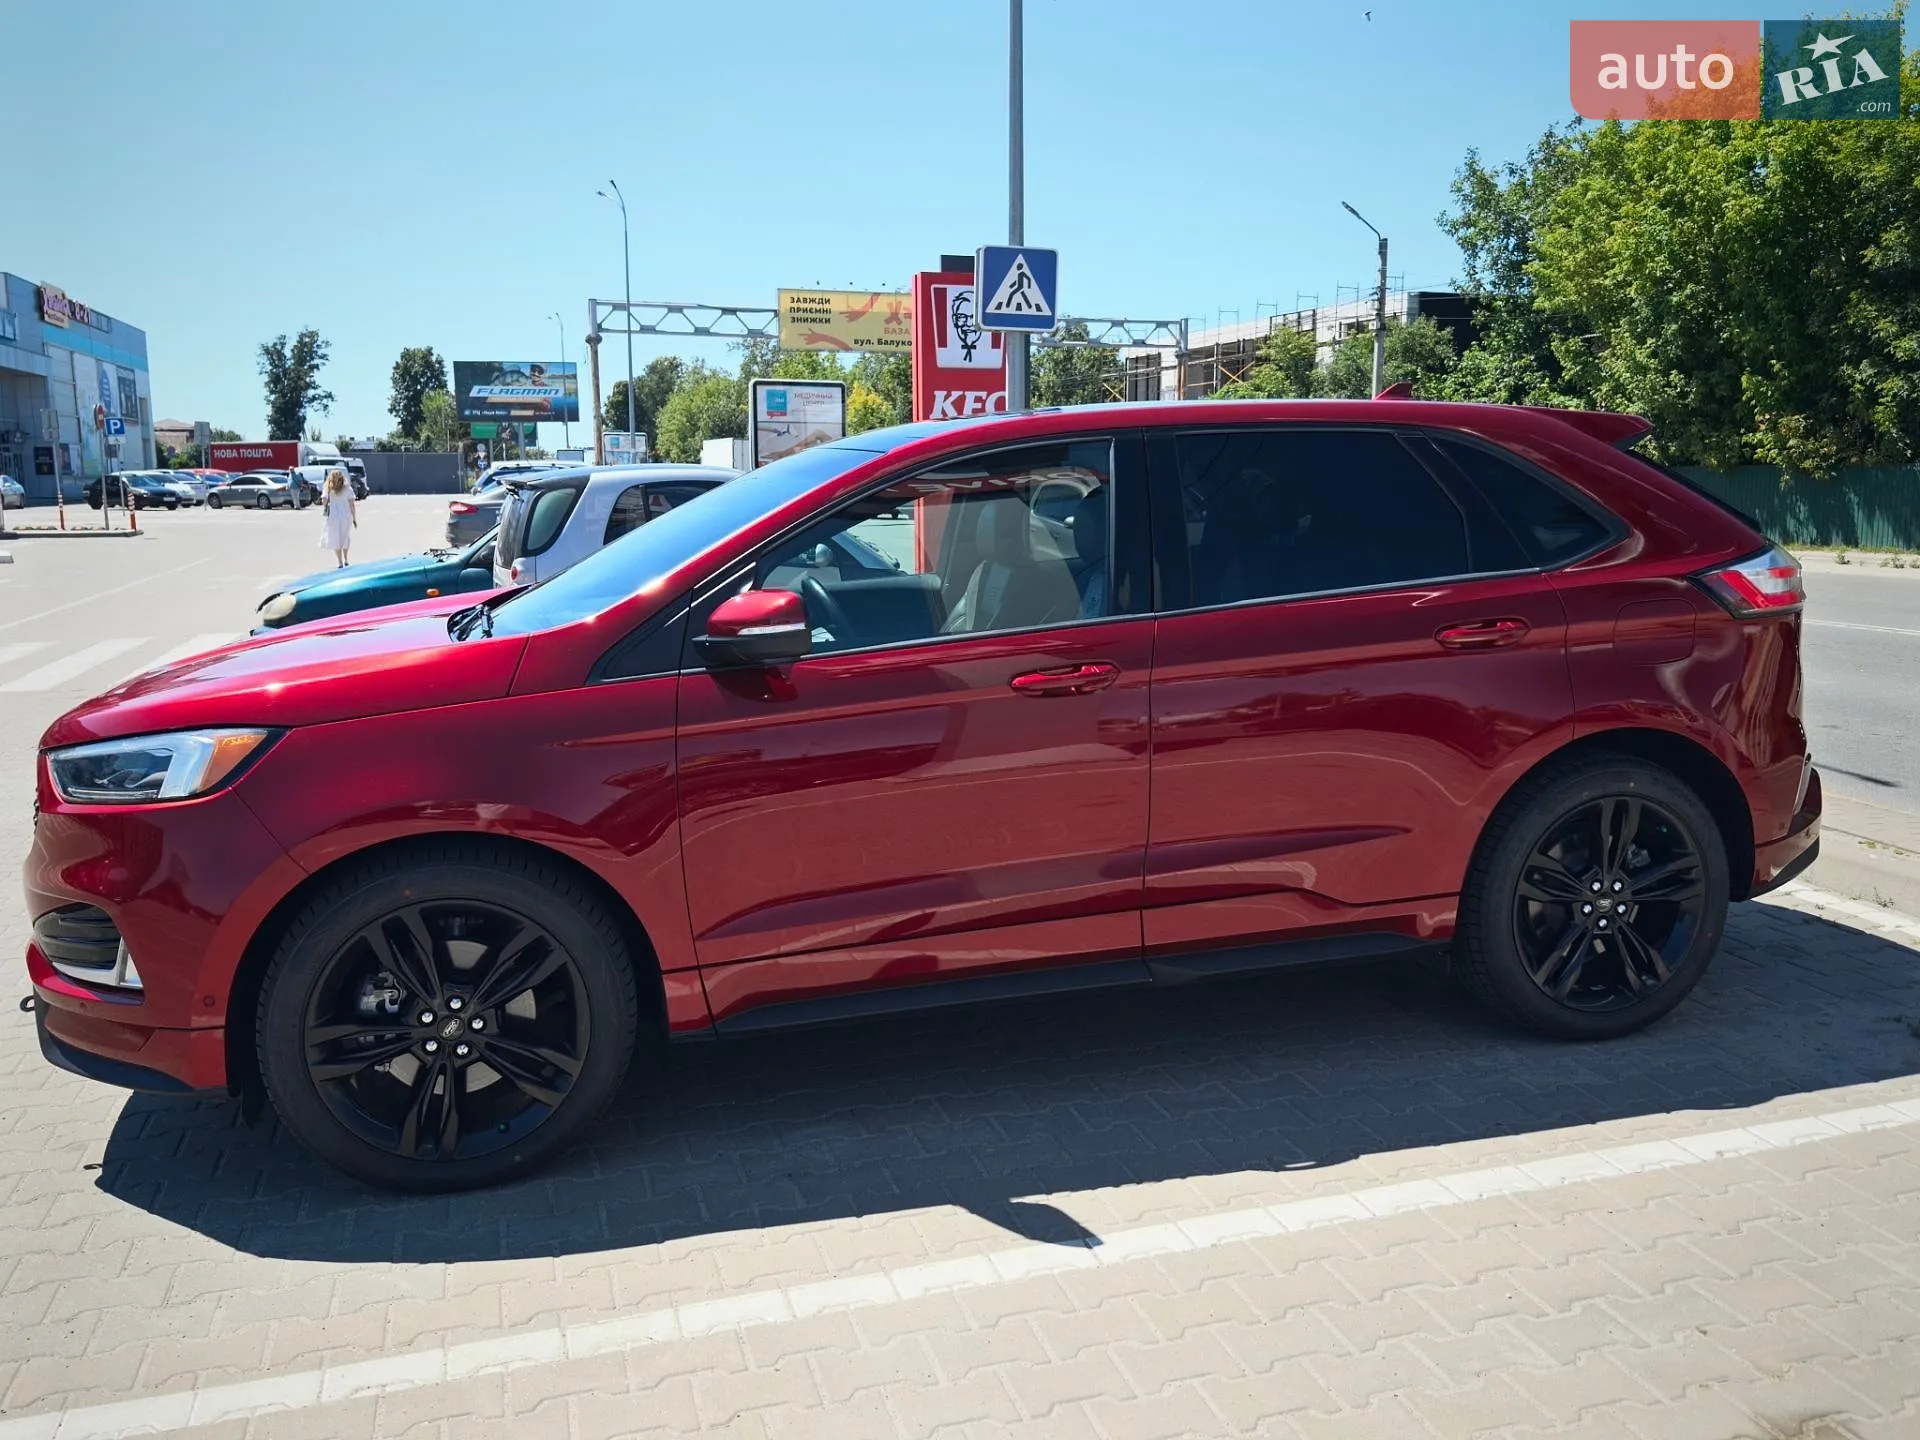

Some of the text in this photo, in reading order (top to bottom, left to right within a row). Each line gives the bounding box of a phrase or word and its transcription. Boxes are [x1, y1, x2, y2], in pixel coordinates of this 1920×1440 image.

[789, 296, 831, 305] ЗАВЖДИ
[789, 307, 832, 315] ПРИЄМНІ
[790, 316, 831, 324] ЗНИЖКИ
[476, 387, 560, 396] FLAGMAN
[929, 390, 1007, 420] KFC
[109, 419, 121, 434] P
[213, 448, 273, 458] НОВА ПОШТА
